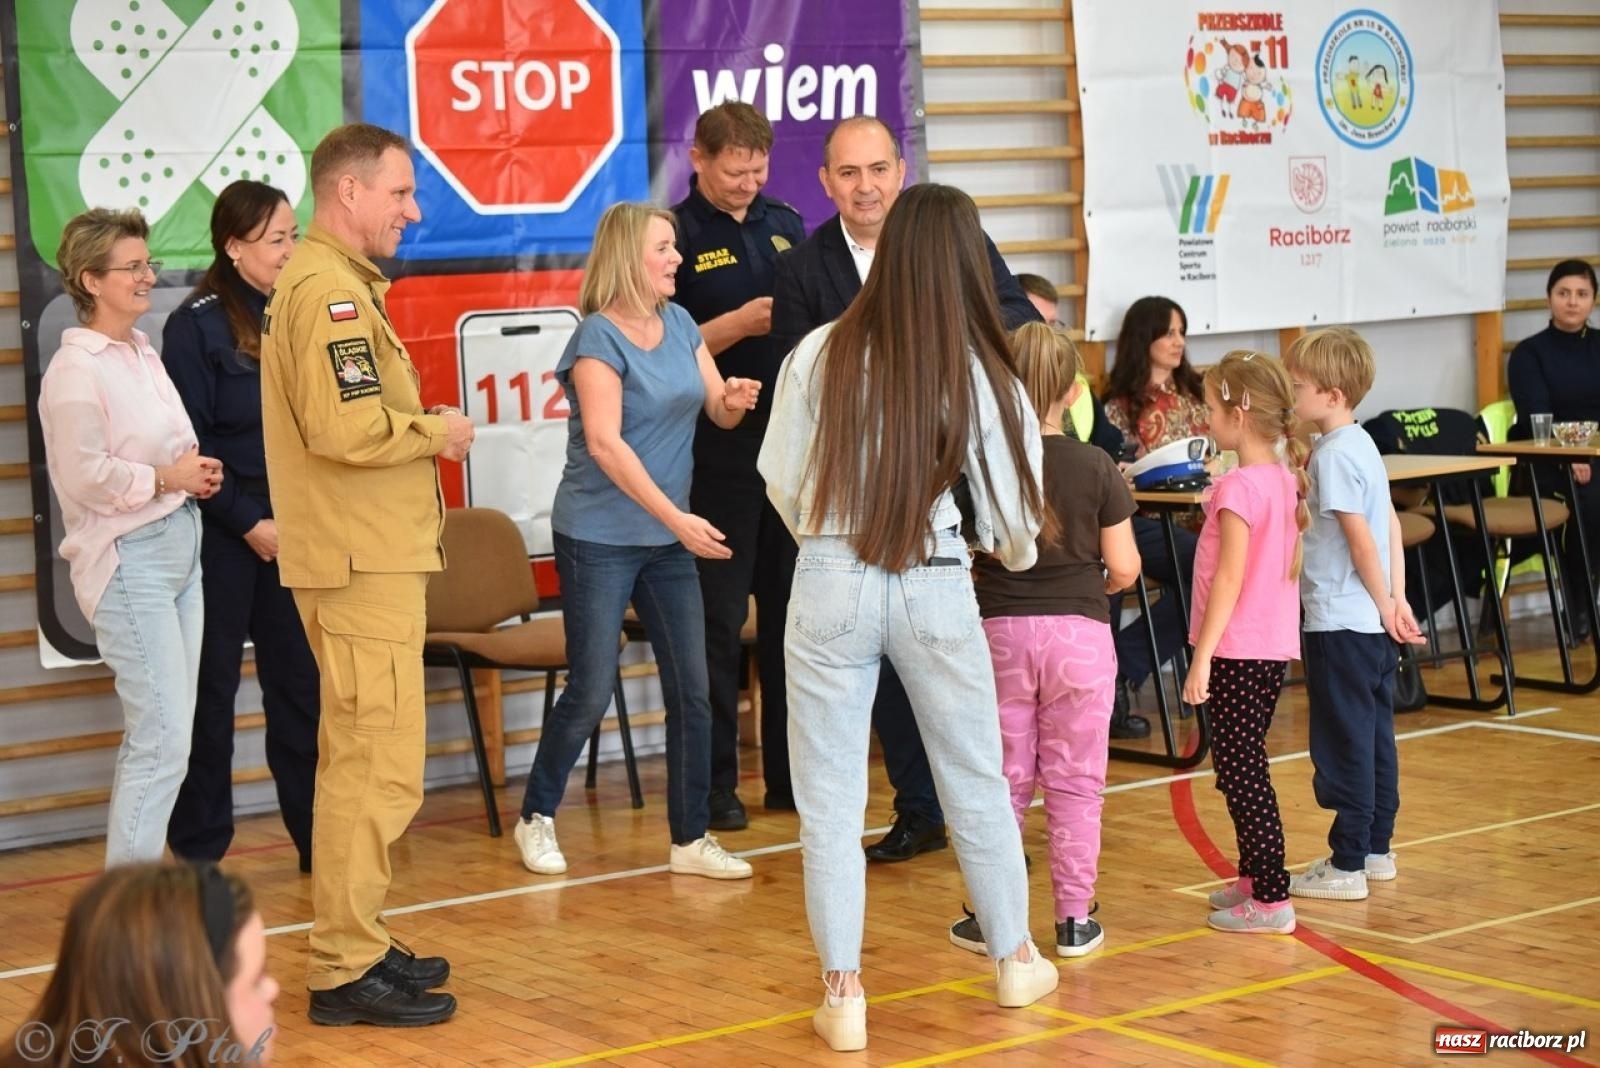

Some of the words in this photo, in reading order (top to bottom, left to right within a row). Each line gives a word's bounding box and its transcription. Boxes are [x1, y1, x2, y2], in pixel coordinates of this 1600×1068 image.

[1198, 12, 1284, 31] PRZEDSZKOLE
[1264, 35, 1288, 69] 11
[451, 60, 591, 111] STOP
[692, 43, 877, 121] wiem
[1269, 225, 1351, 247] Racibórz
[1383, 220, 1420, 237] powiat
[1426, 216, 1477, 232] raciborski
[1178, 238, 1214, 246] Powiatowe
[694, 255, 739, 273] MIEJSKA
[1178, 250, 1208, 258] Centrum
[1300, 253, 1322, 268] 1217
[476, 371, 571, 424] 112
